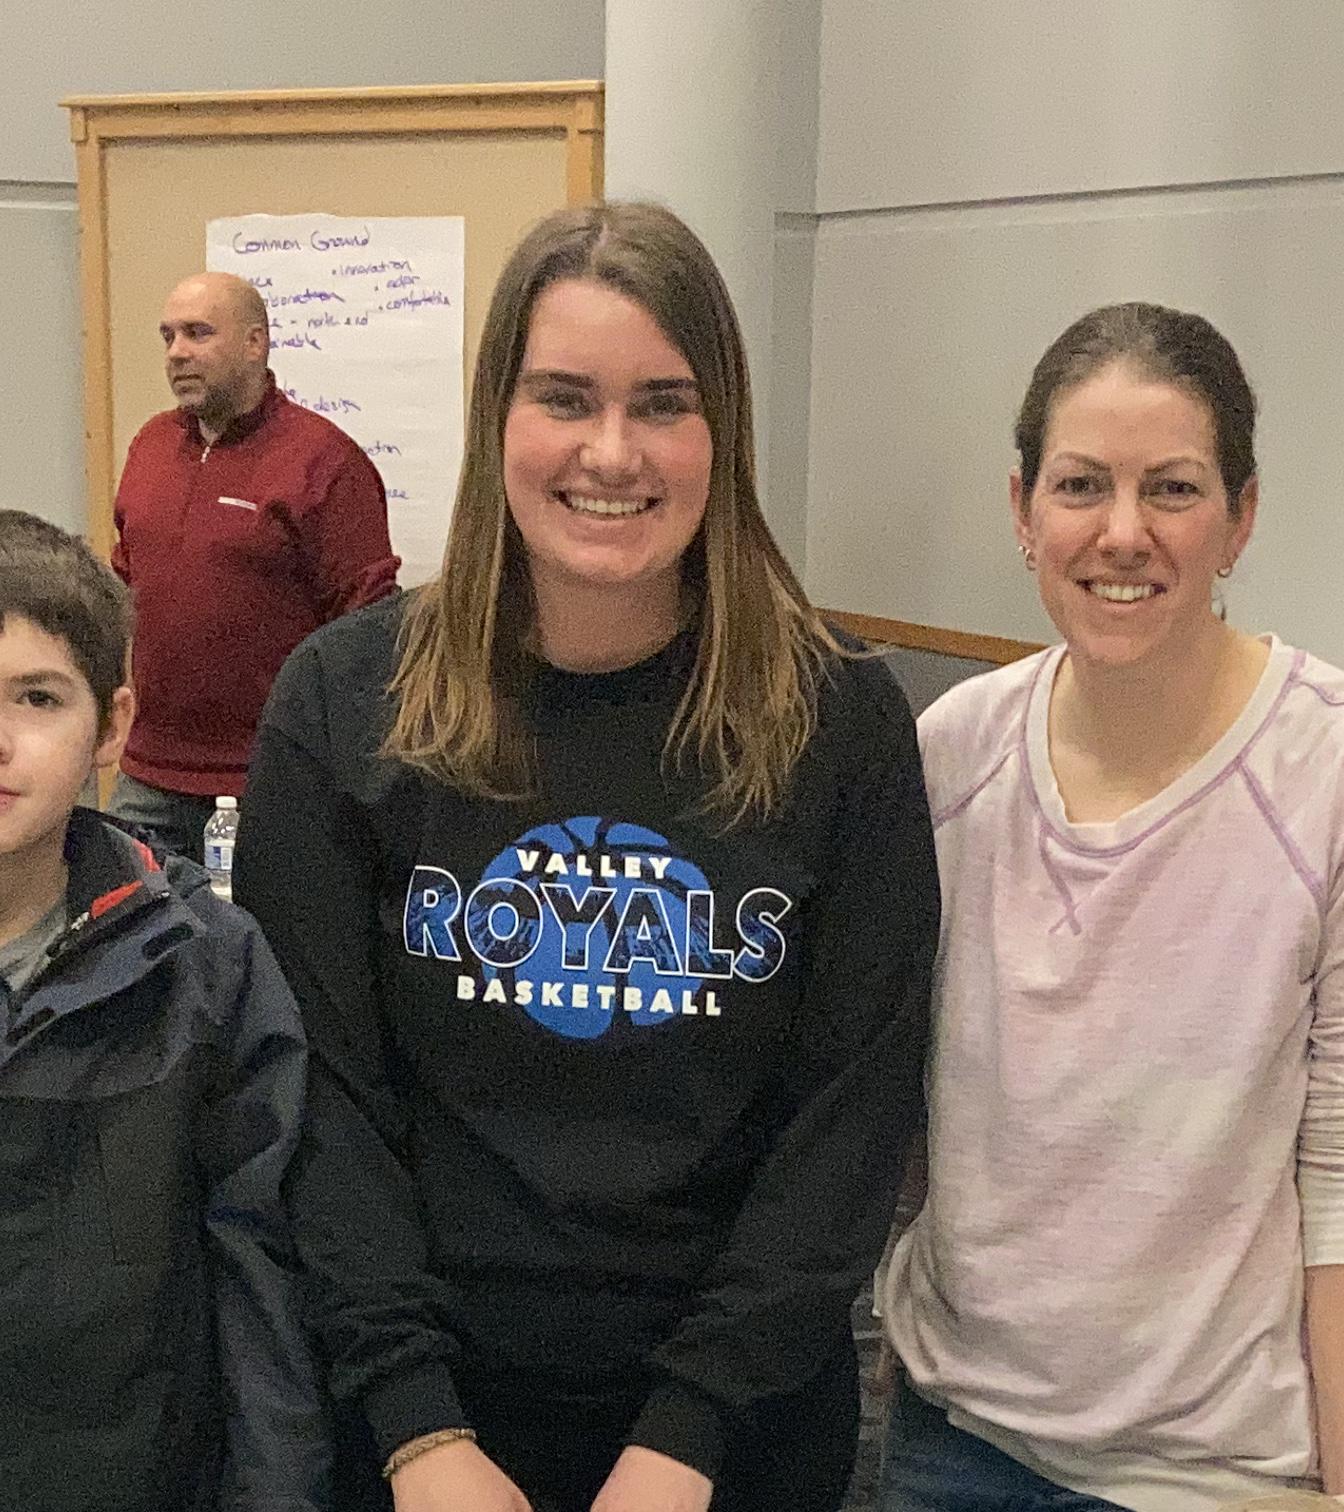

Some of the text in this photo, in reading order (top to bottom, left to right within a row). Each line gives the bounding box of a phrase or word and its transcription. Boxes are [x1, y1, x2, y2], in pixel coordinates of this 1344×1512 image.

[232, 225, 371, 254] Common Ground
[516, 848, 672, 880] VALLEY
[403, 865, 793, 983] ROYALS
[456, 975, 722, 1017] BASKETBALL
